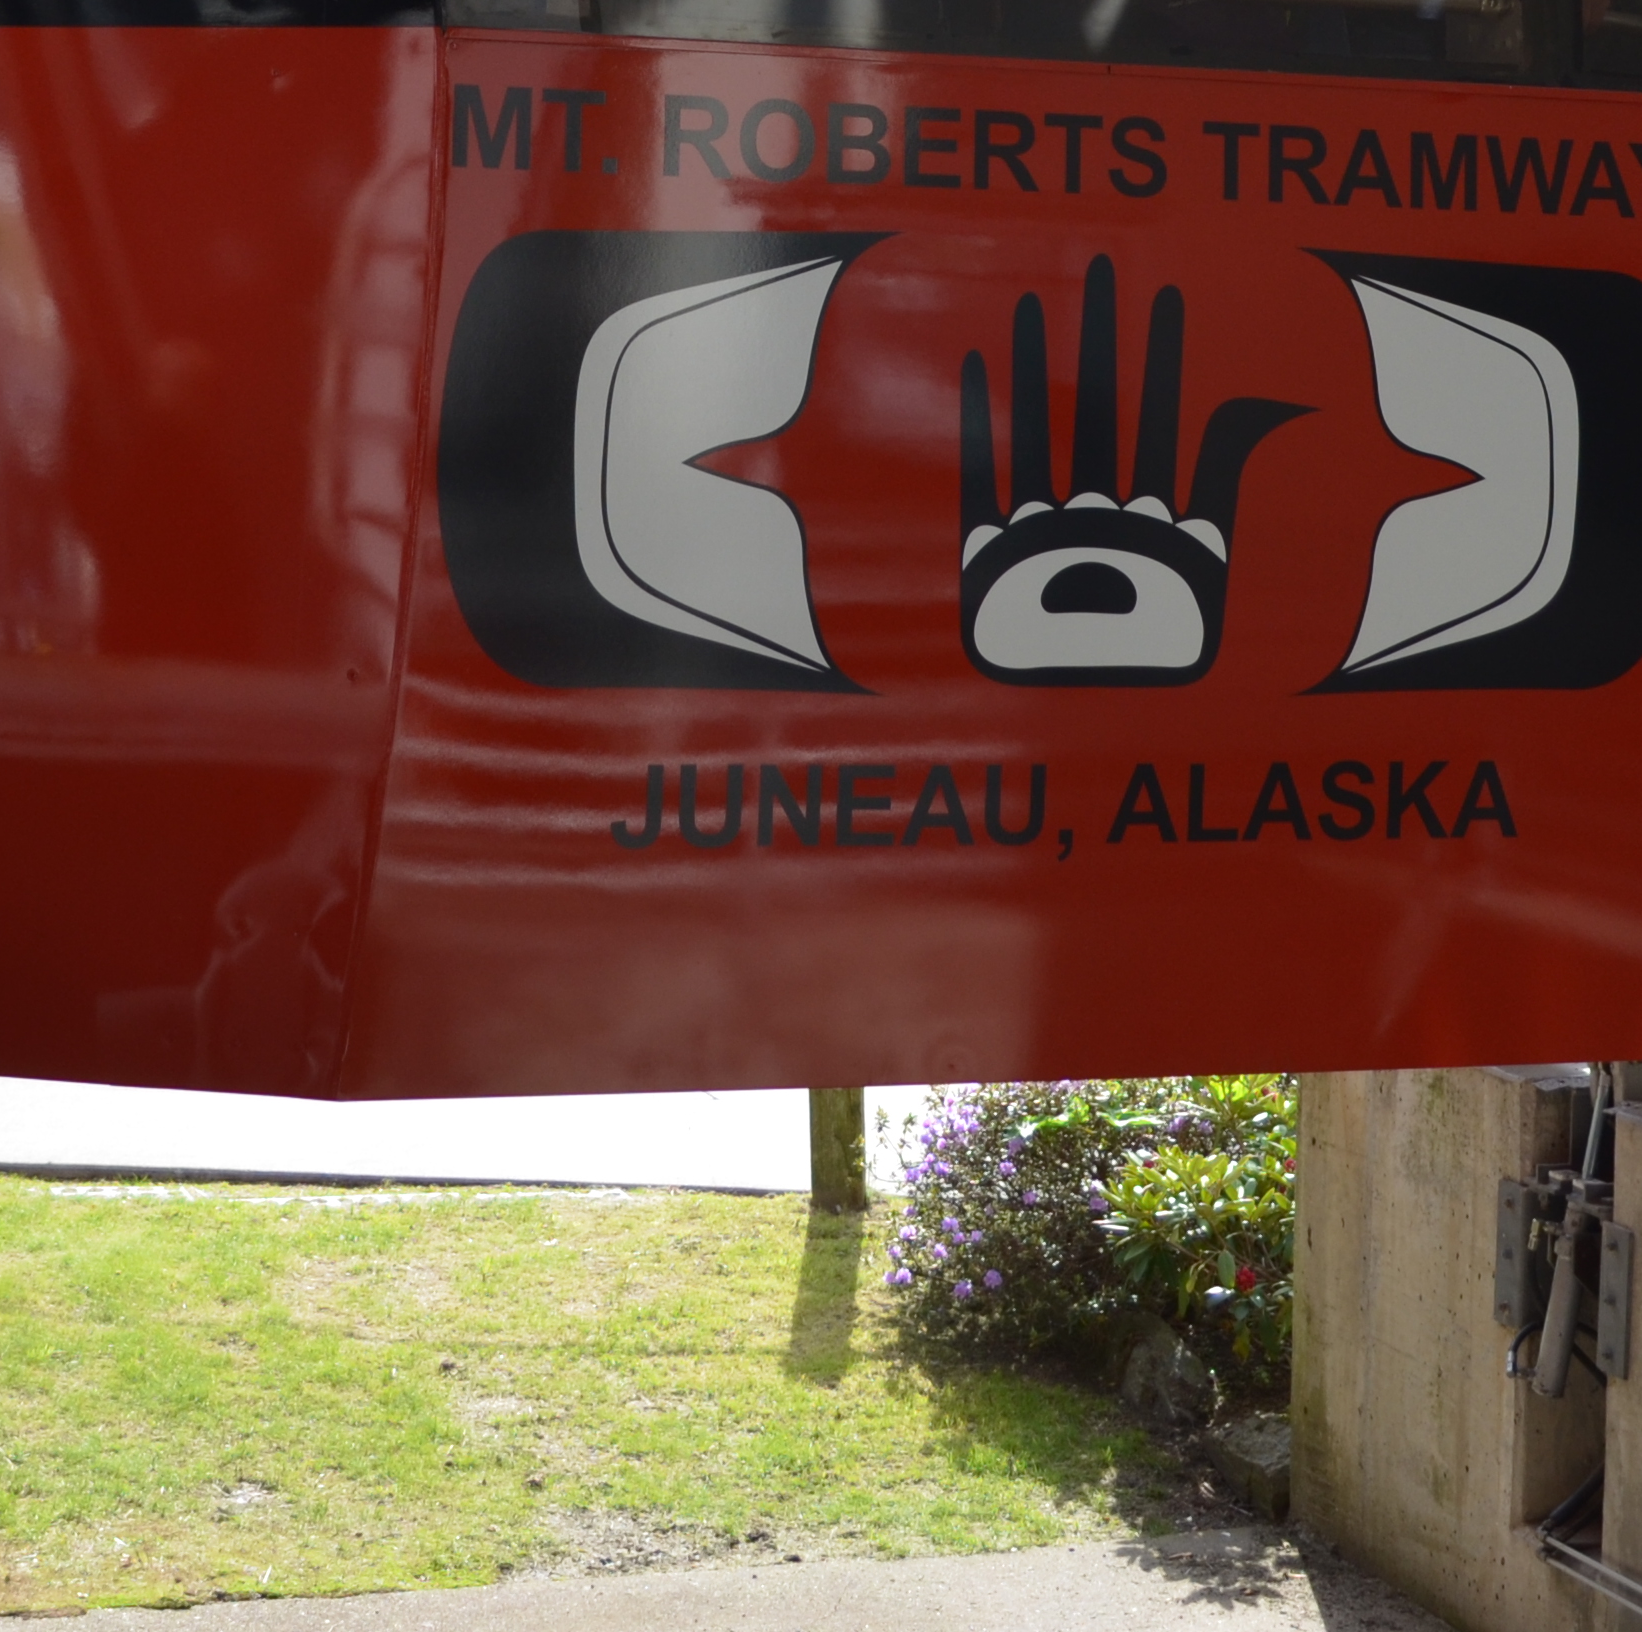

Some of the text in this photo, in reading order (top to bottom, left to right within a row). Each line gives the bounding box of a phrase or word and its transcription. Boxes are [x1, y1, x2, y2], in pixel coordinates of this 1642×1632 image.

[449, 84, 620, 174] MT.
[662, 94, 1169, 198] ROBERTS
[610, 759, 1518, 859] JUNEAU, ALASKA
